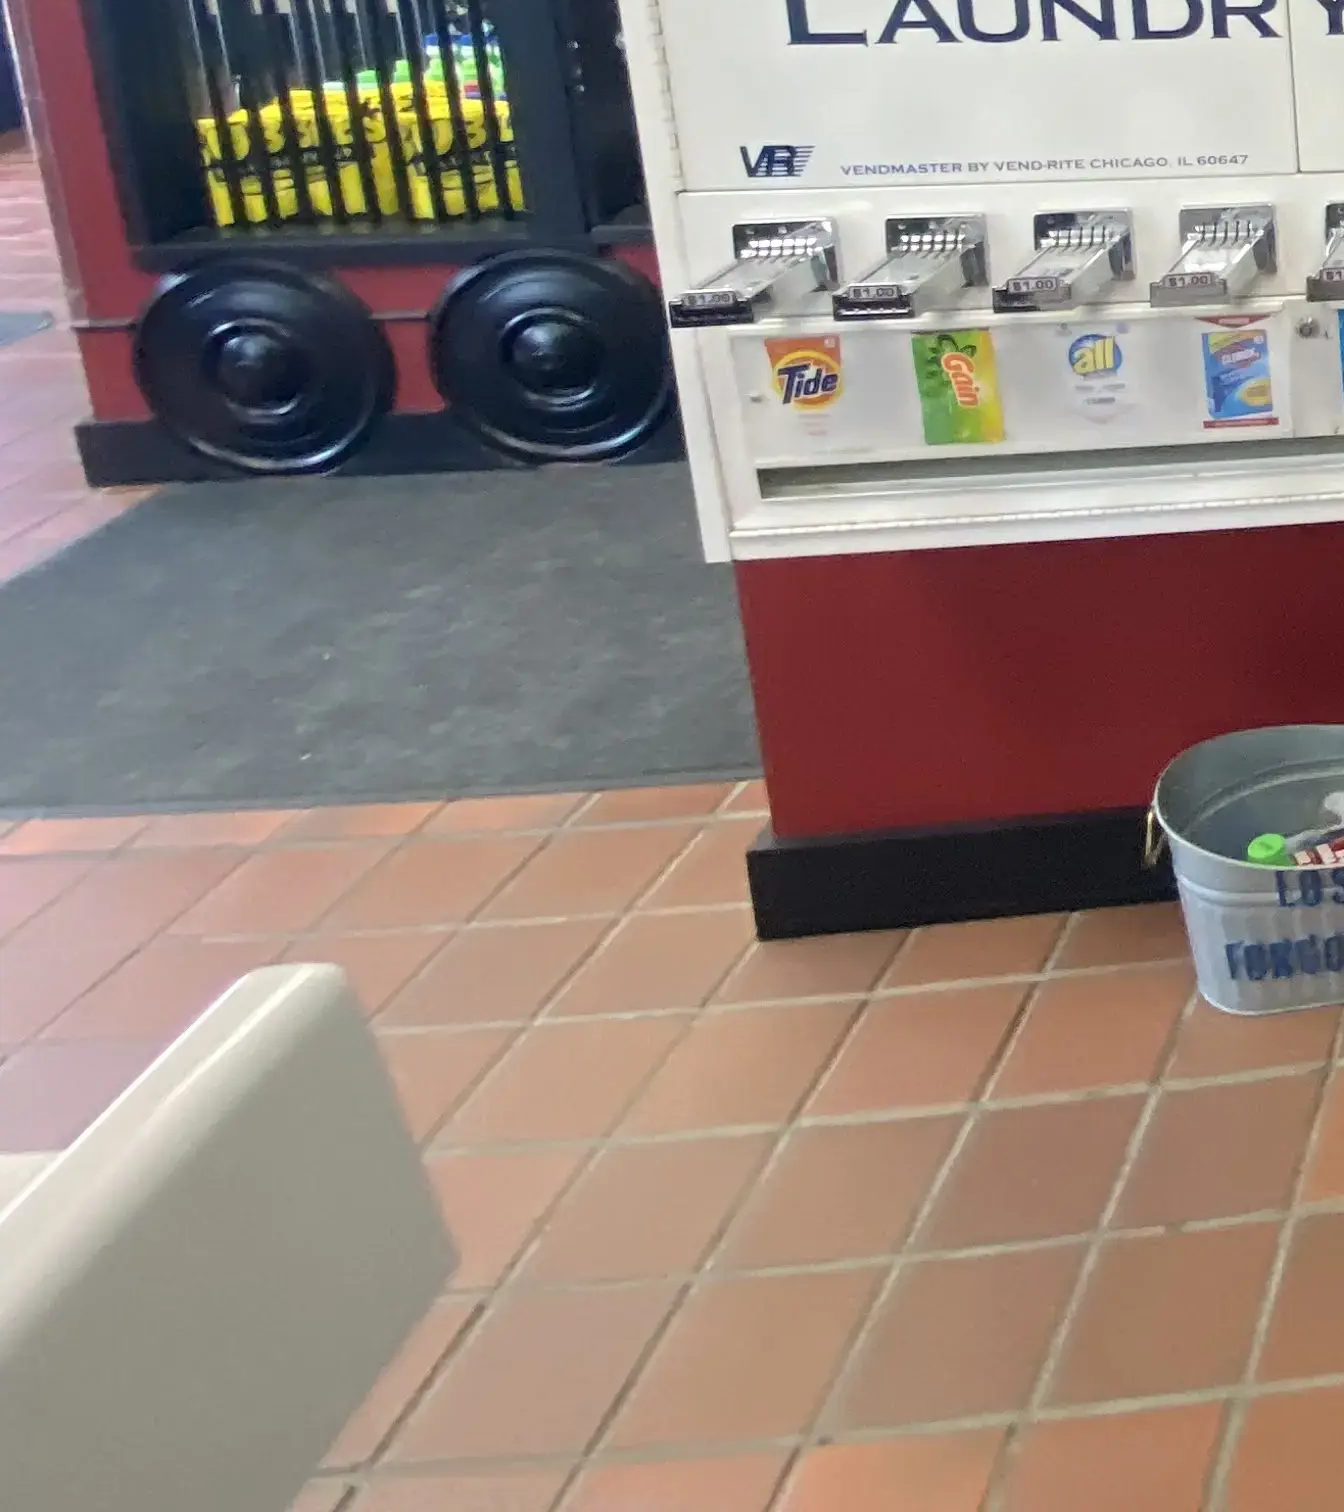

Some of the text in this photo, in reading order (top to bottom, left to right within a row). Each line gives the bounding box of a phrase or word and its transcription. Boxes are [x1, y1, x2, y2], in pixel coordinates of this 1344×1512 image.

[840, 162, 963, 178] VENDMASTER
[967, 161, 990, 174] BY
[996, 158, 1086, 172] VEND-RITE
[1177, 156, 1193, 167] IL
[1196, 154, 1249, 166] 60647
[1013, 280, 1054, 291] $1.00
[1168, 275, 1208, 287] $1.00
[1073, 336, 1116, 375] all
[777, 363, 839, 405] Tide
[941, 353, 980, 407] Gain
